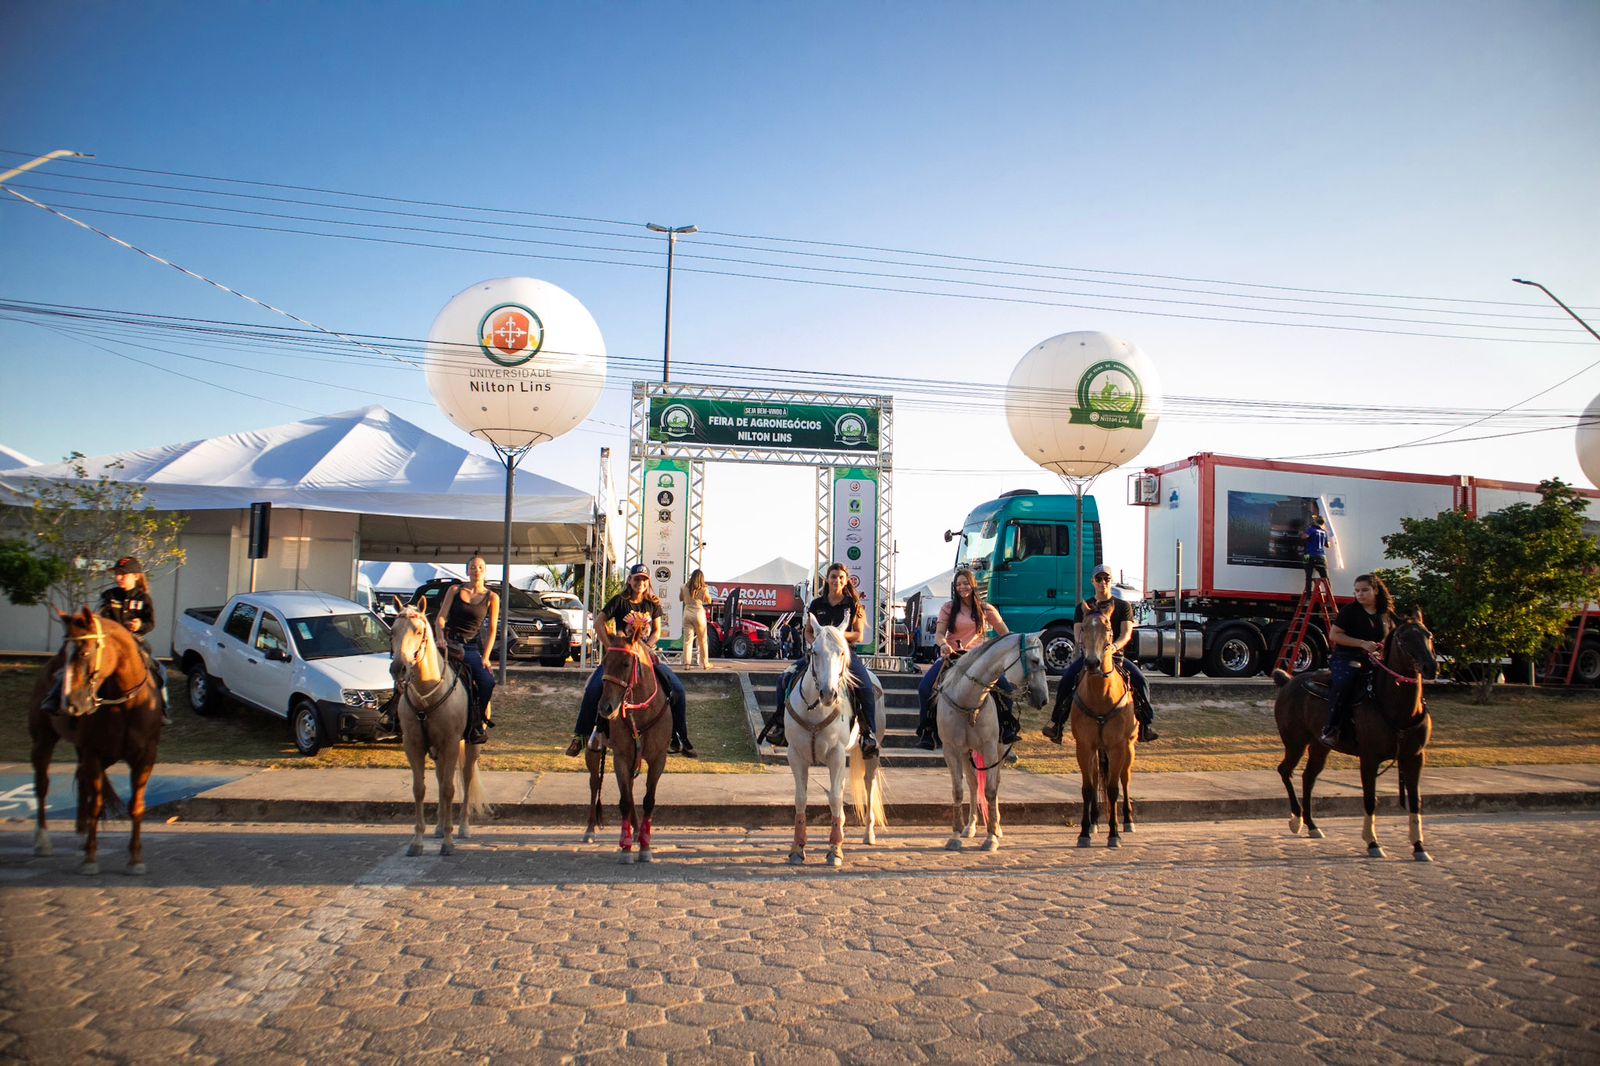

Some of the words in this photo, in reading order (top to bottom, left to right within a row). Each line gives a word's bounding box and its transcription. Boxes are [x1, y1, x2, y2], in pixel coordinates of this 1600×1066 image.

[469, 368, 552, 378] UNIVERSIDADE
[470, 381, 515, 393] Nilton
[520, 381, 551, 393] Lins
[708, 416, 734, 427] FEIRA
[736, 417, 749, 427] DE
[750, 417, 822, 430] AGRONEGÓCIOS
[737, 431, 771, 442] NILTON
[772, 432, 793, 443] LINS
[720, 587, 777, 599] AROAM
